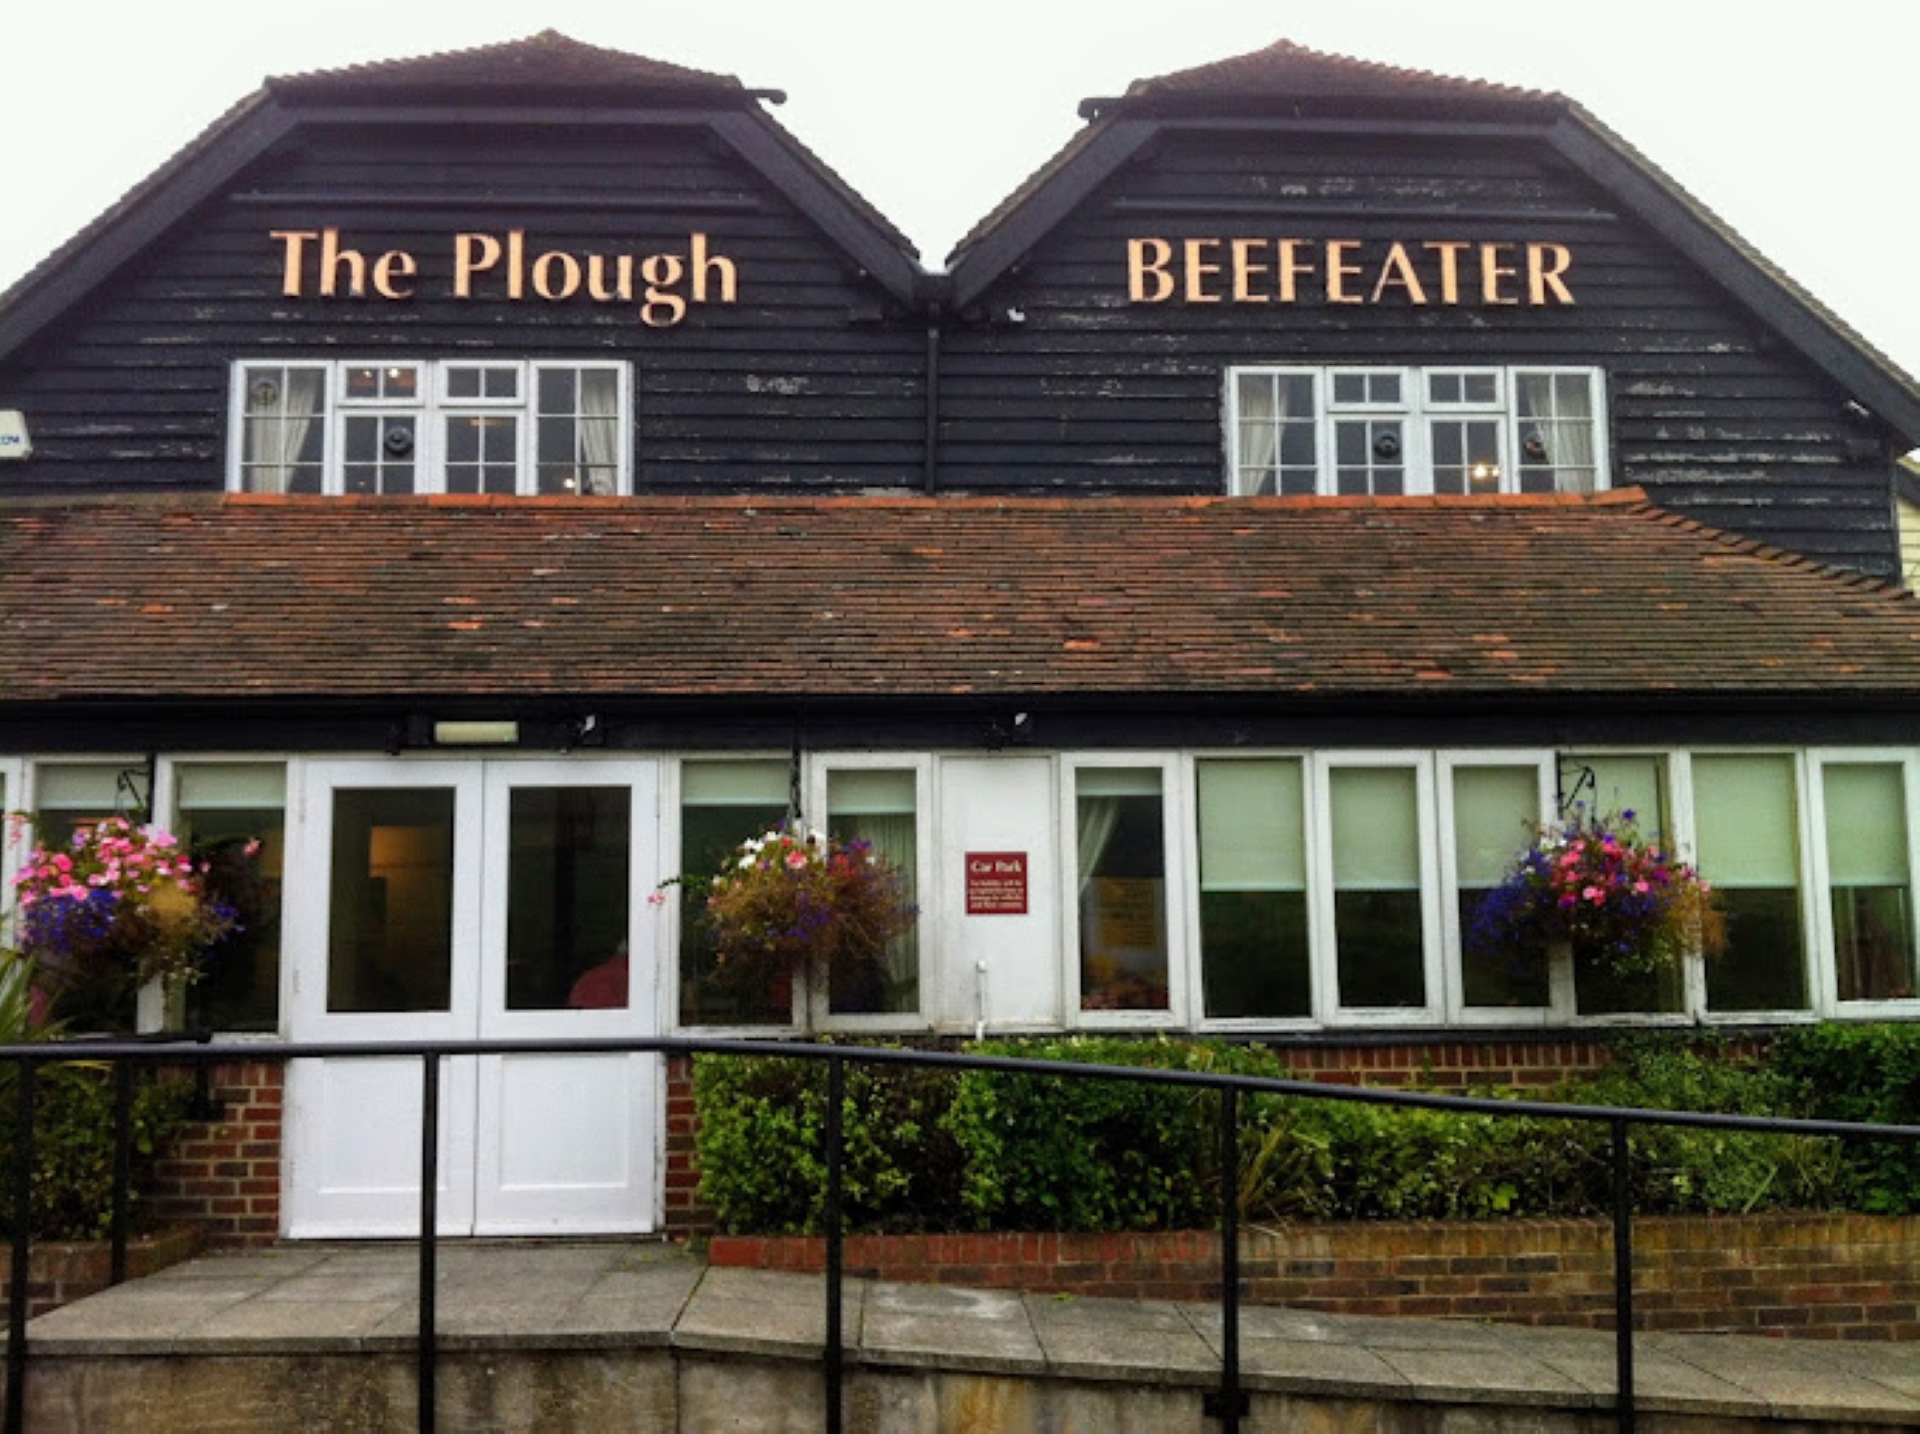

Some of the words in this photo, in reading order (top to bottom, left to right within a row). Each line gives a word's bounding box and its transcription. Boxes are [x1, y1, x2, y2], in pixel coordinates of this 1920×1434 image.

[270, 228, 416, 298] The
[454, 229, 737, 326] Plough
[1127, 238, 1574, 304] BEEFEATER
[970, 860, 993, 873] Car
[996, 860, 1022, 873] Park
